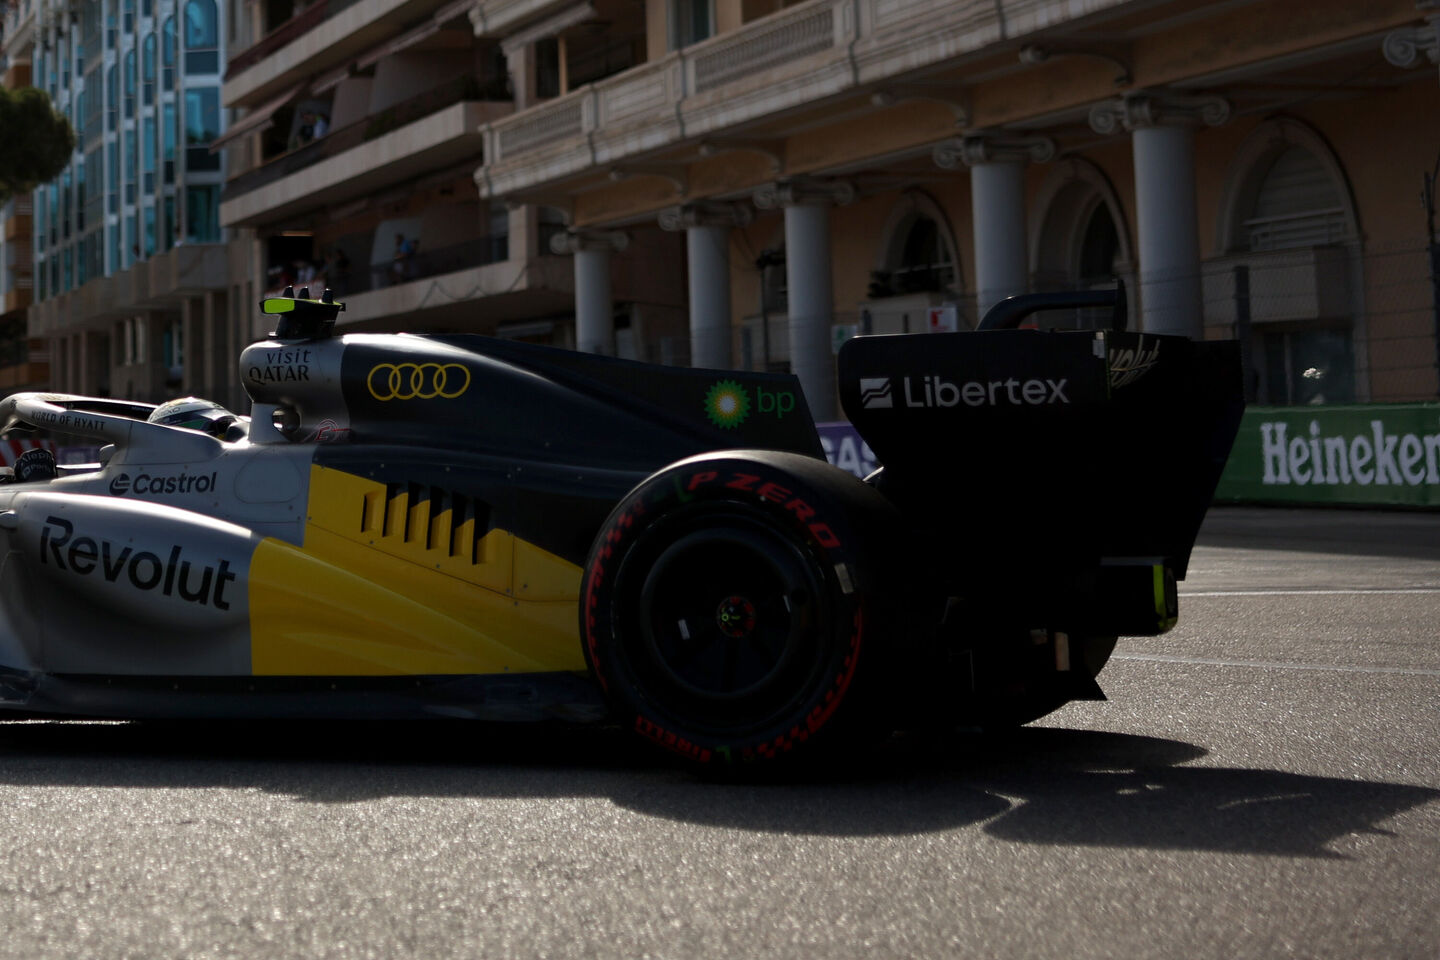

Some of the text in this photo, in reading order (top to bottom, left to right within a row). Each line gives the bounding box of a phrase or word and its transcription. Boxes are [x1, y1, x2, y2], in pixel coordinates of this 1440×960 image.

[267, 348, 312, 364] visit
[249, 366, 310, 386] QATAR
[756, 385, 796, 419] bp
[903, 374, 1072, 409] Libertex
[31, 410, 106, 432] WORLD OF HYATT
[133, 472, 217, 495] Castrol
[687, 471, 841, 549] P ZERO
[40, 515, 236, 611] Revolut
